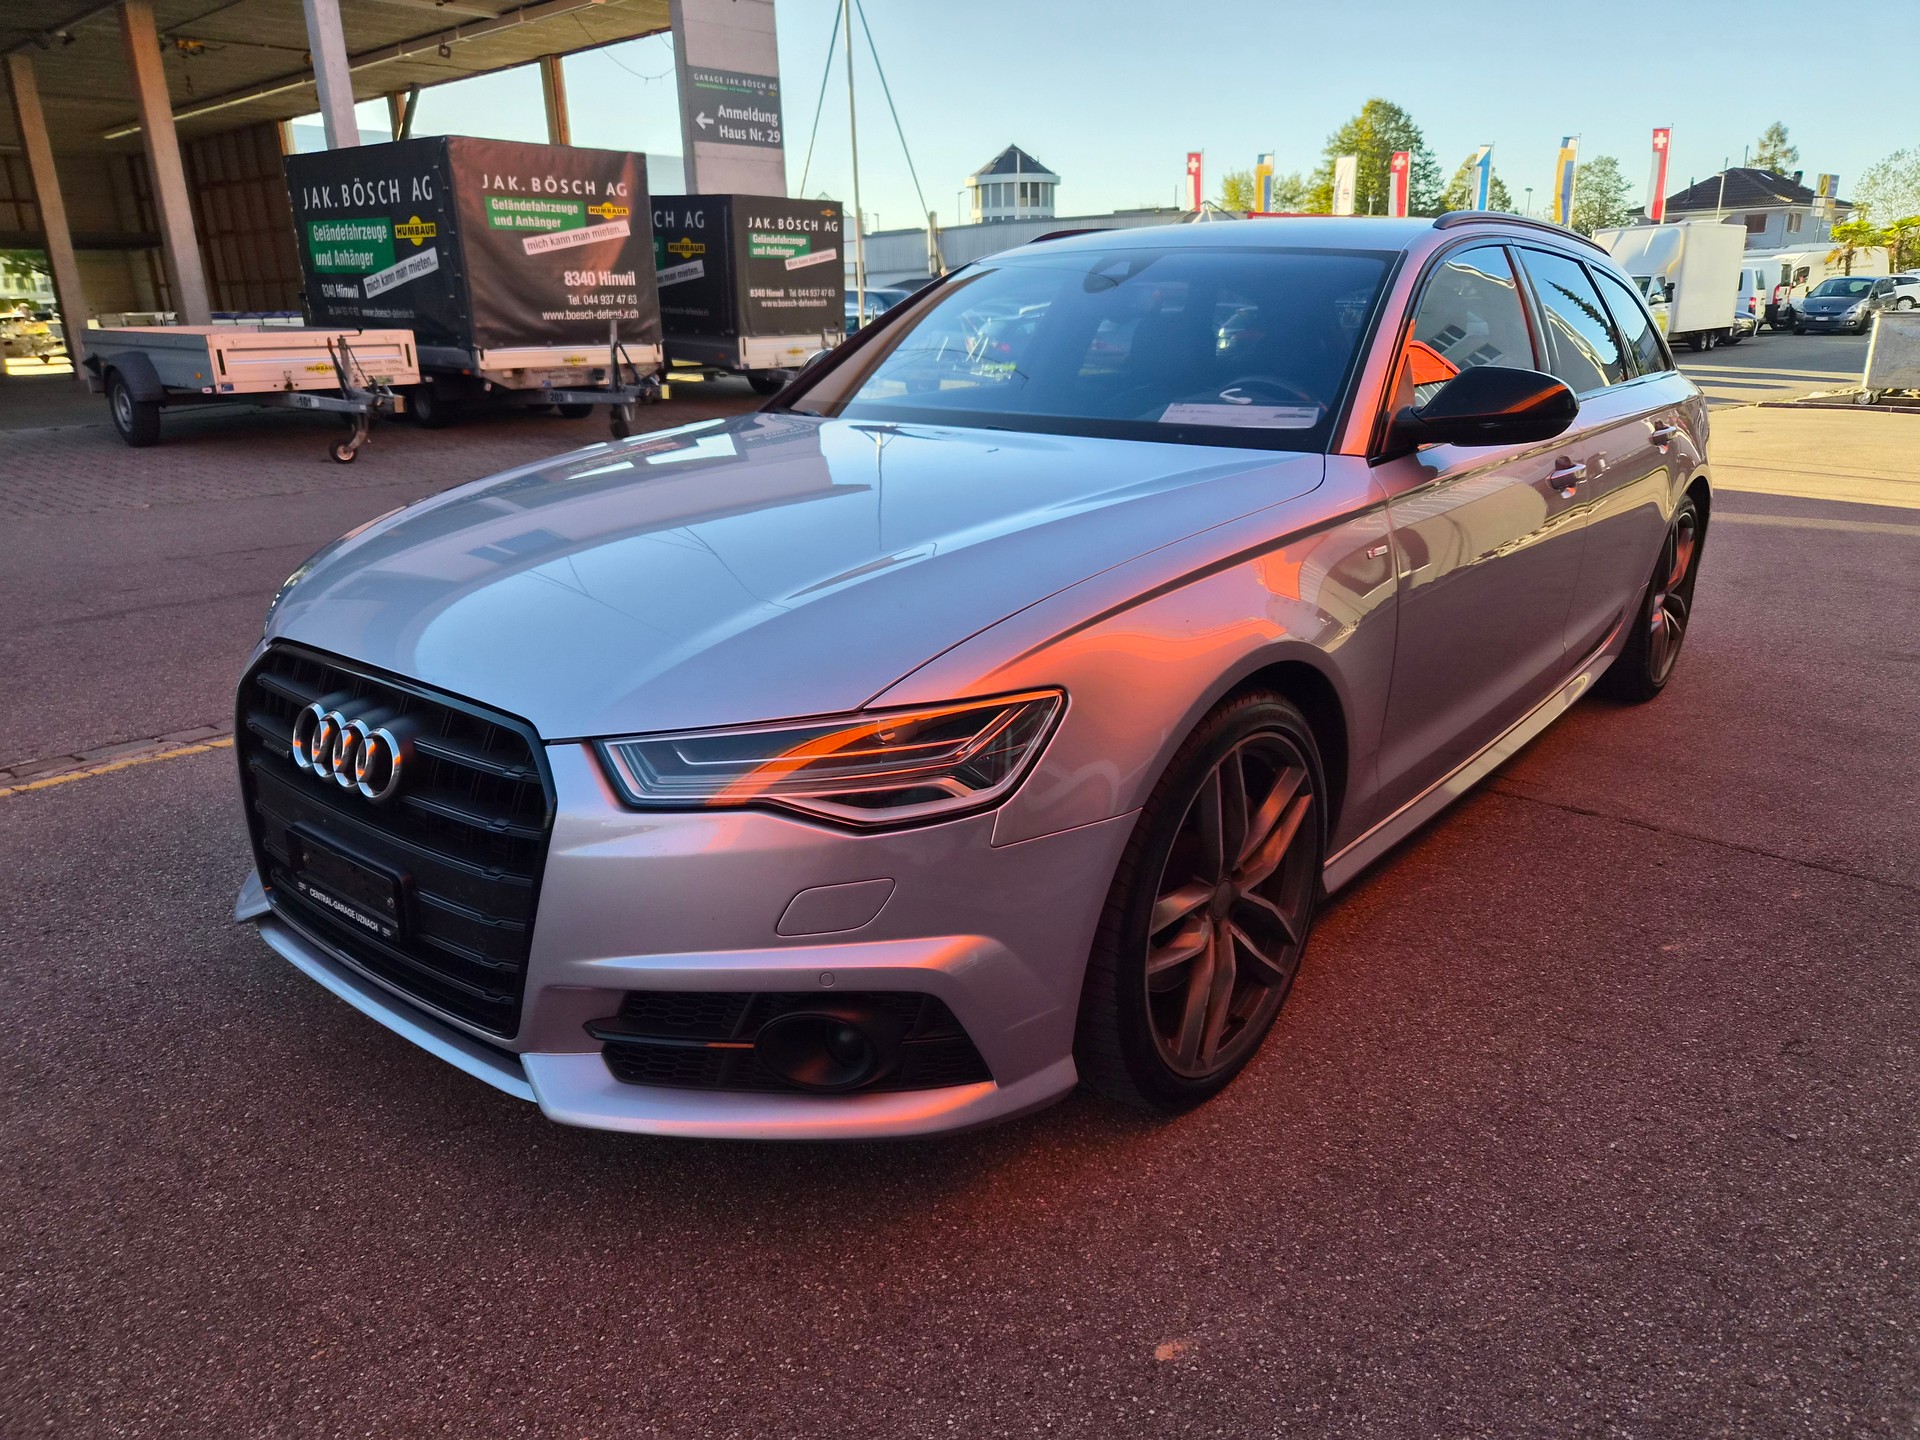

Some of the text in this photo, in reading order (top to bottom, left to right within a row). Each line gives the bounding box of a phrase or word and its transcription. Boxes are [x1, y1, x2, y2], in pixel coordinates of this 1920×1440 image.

[694, 73, 723, 84] GARAGE
[718, 105, 778, 127] Anmeldung
[720, 125, 780, 143] Haus Nr. 29
[303, 175, 433, 210] JAK. BÖSCH AG
[482, 174, 627, 197] JAK. BÖSCH AG
[491, 199, 578, 216] Geländefahrzeuge
[590, 207, 627, 215] HUMBAUR
[494, 215, 561, 229] und Anhänger
[685, 211, 704, 228] AG
[748, 217, 838, 232] JAK. BÖSCH AG
[313, 224, 388, 243] Geländefahrzeuge
[396, 225, 435, 236] HUMBAUR
[527, 238, 548, 250] mich
[550, 235, 571, 246] kann
[572, 232, 590, 242] man
[752, 234, 806, 246] Geländefahrzeuge
[669, 244, 704, 252] HUMBAUR
[752, 246, 795, 257] und Anhänger
[315, 249, 374, 269] und Anhänger
[366, 276, 380, 293] mich
[381, 271, 395, 287] kann
[396, 265, 408, 280] man
[564, 271, 636, 286] 8340 Hinwil
[335, 283, 359, 298] Hinwil
[766, 289, 784, 298] Hinwil
[567, 294, 638, 305] Tel. 044 937 47 63
[551, 393, 564, 402] 203
[309, 888, 379, 932] CENTRAL-GARAGE UZNACH
